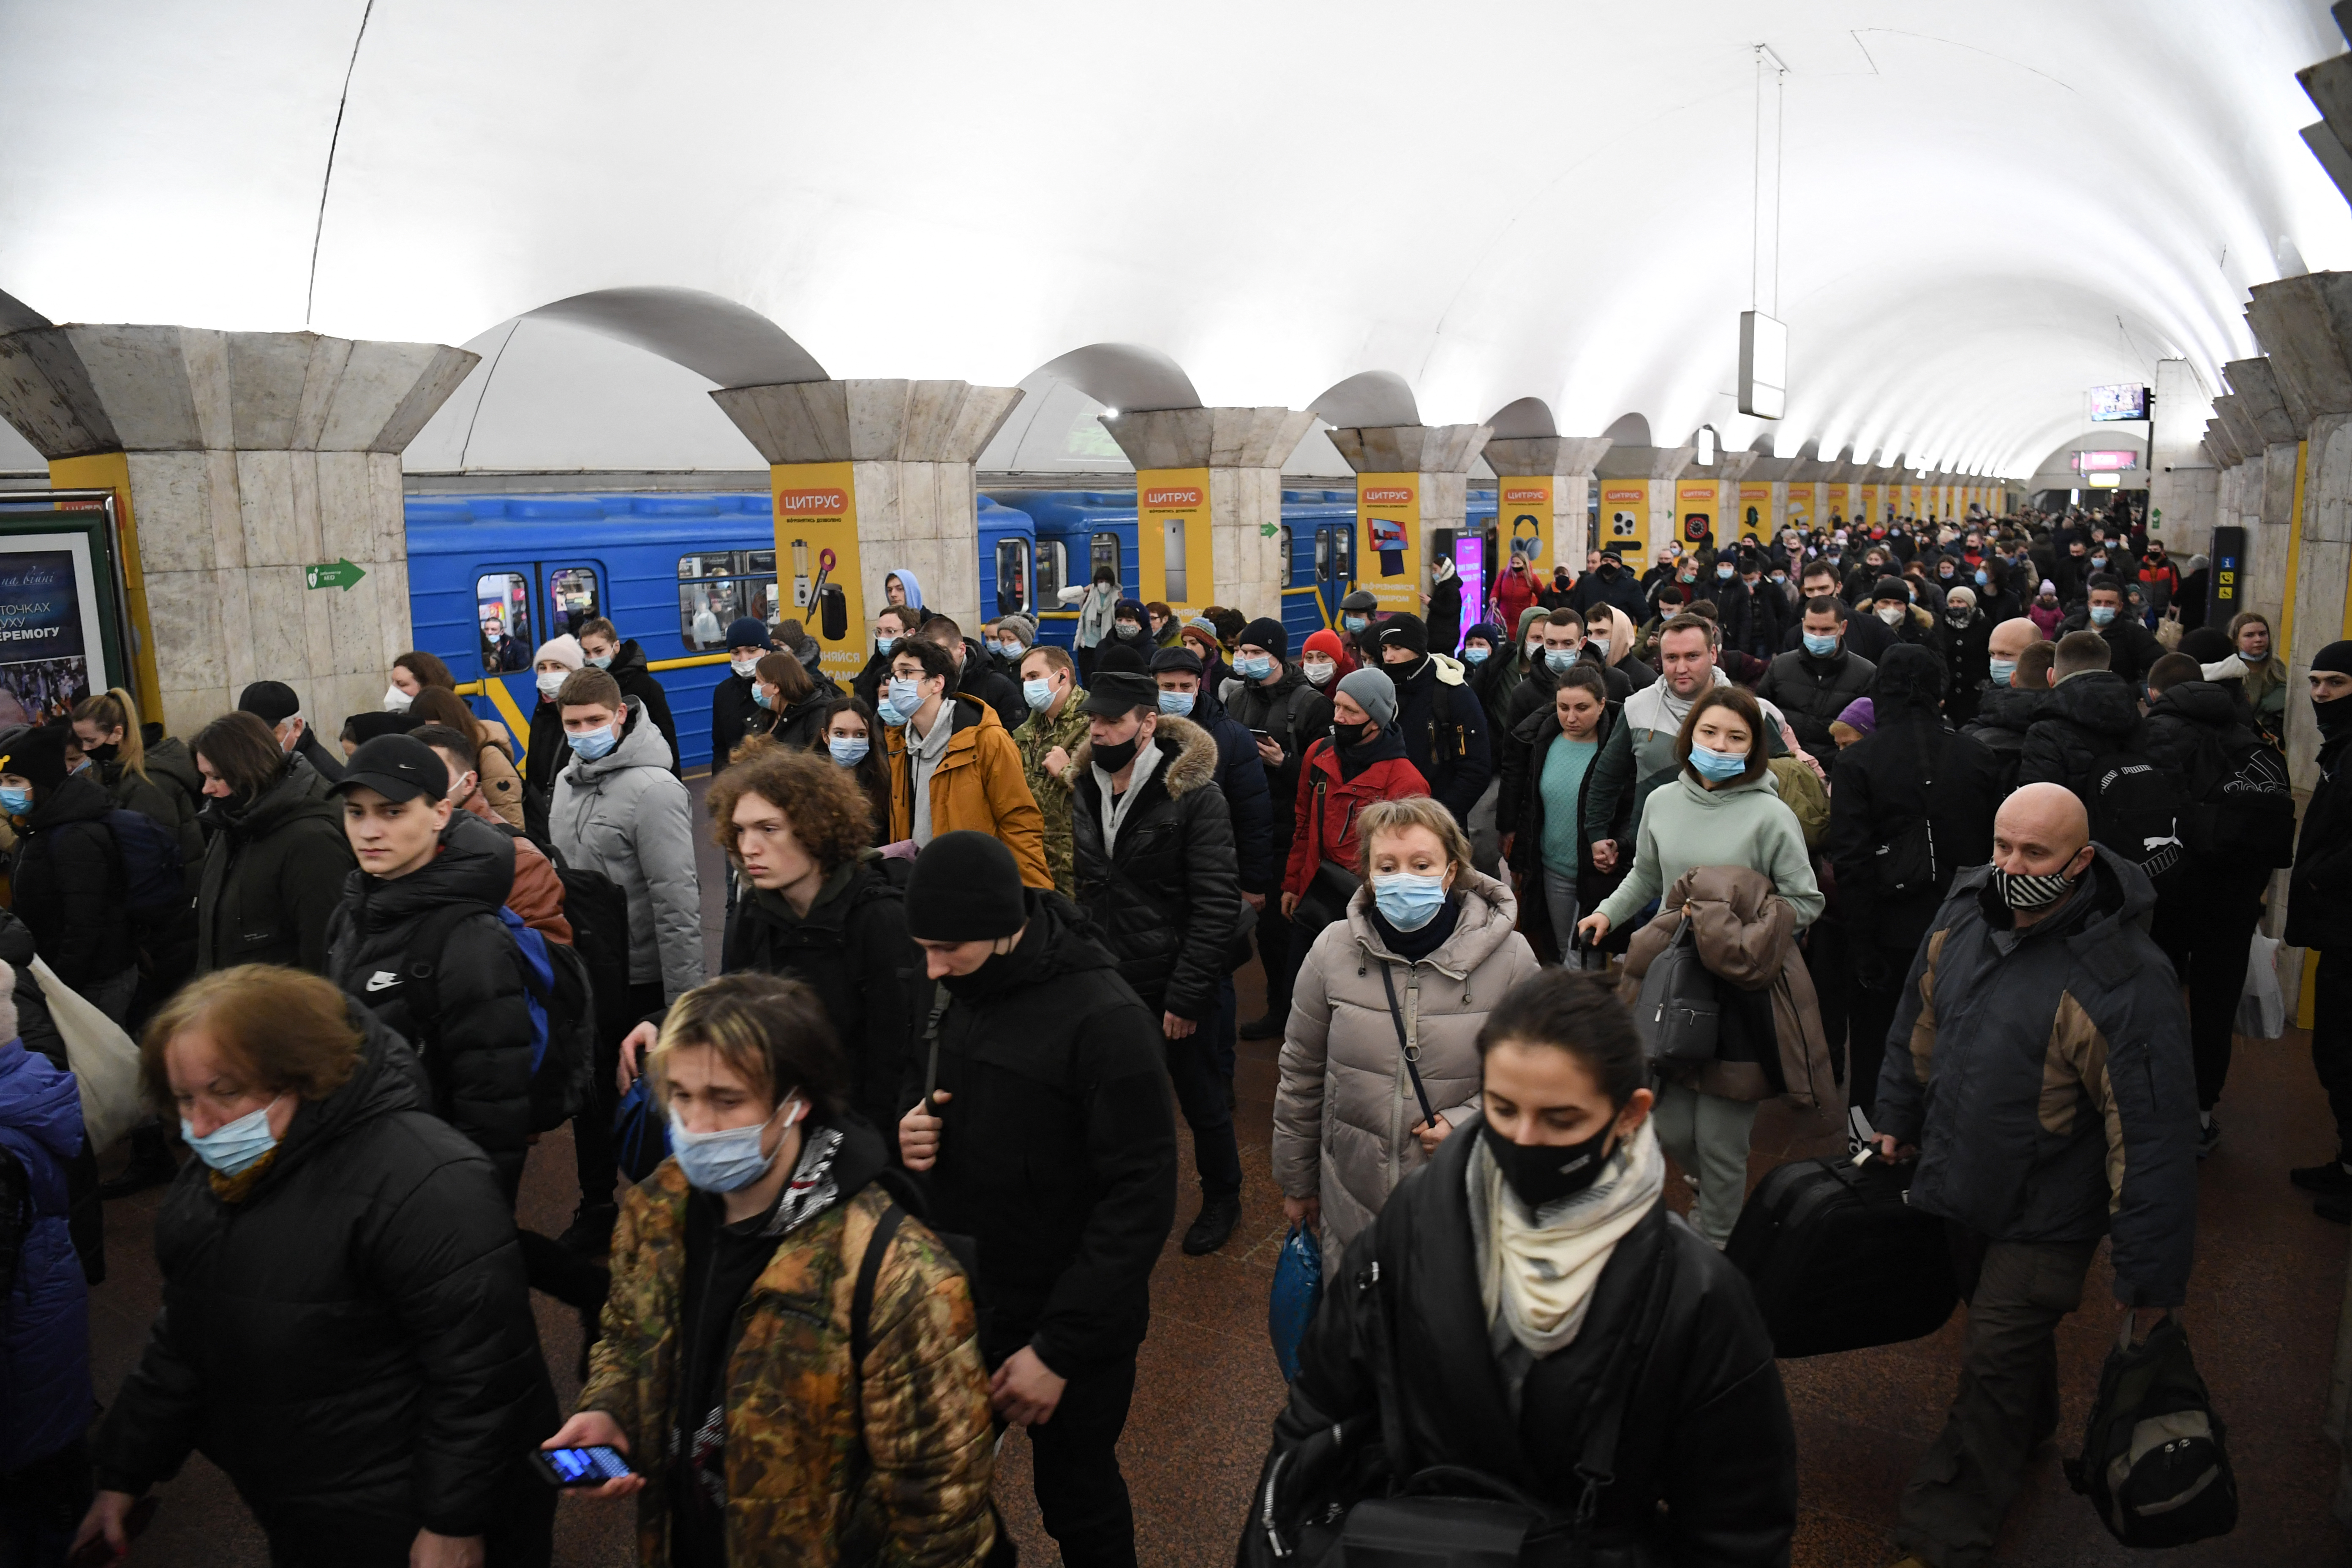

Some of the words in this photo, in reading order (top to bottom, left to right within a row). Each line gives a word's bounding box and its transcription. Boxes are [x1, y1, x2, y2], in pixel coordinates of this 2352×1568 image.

[785, 495, 840, 509] ЦИТРУС
[1149, 492, 1196, 504] ЦИТРУС
[1367, 491, 1407, 500] ЦИТРУС
[0, 602, 51, 615] ТОЧКАХ
[0, 617, 25, 630] УХУ
